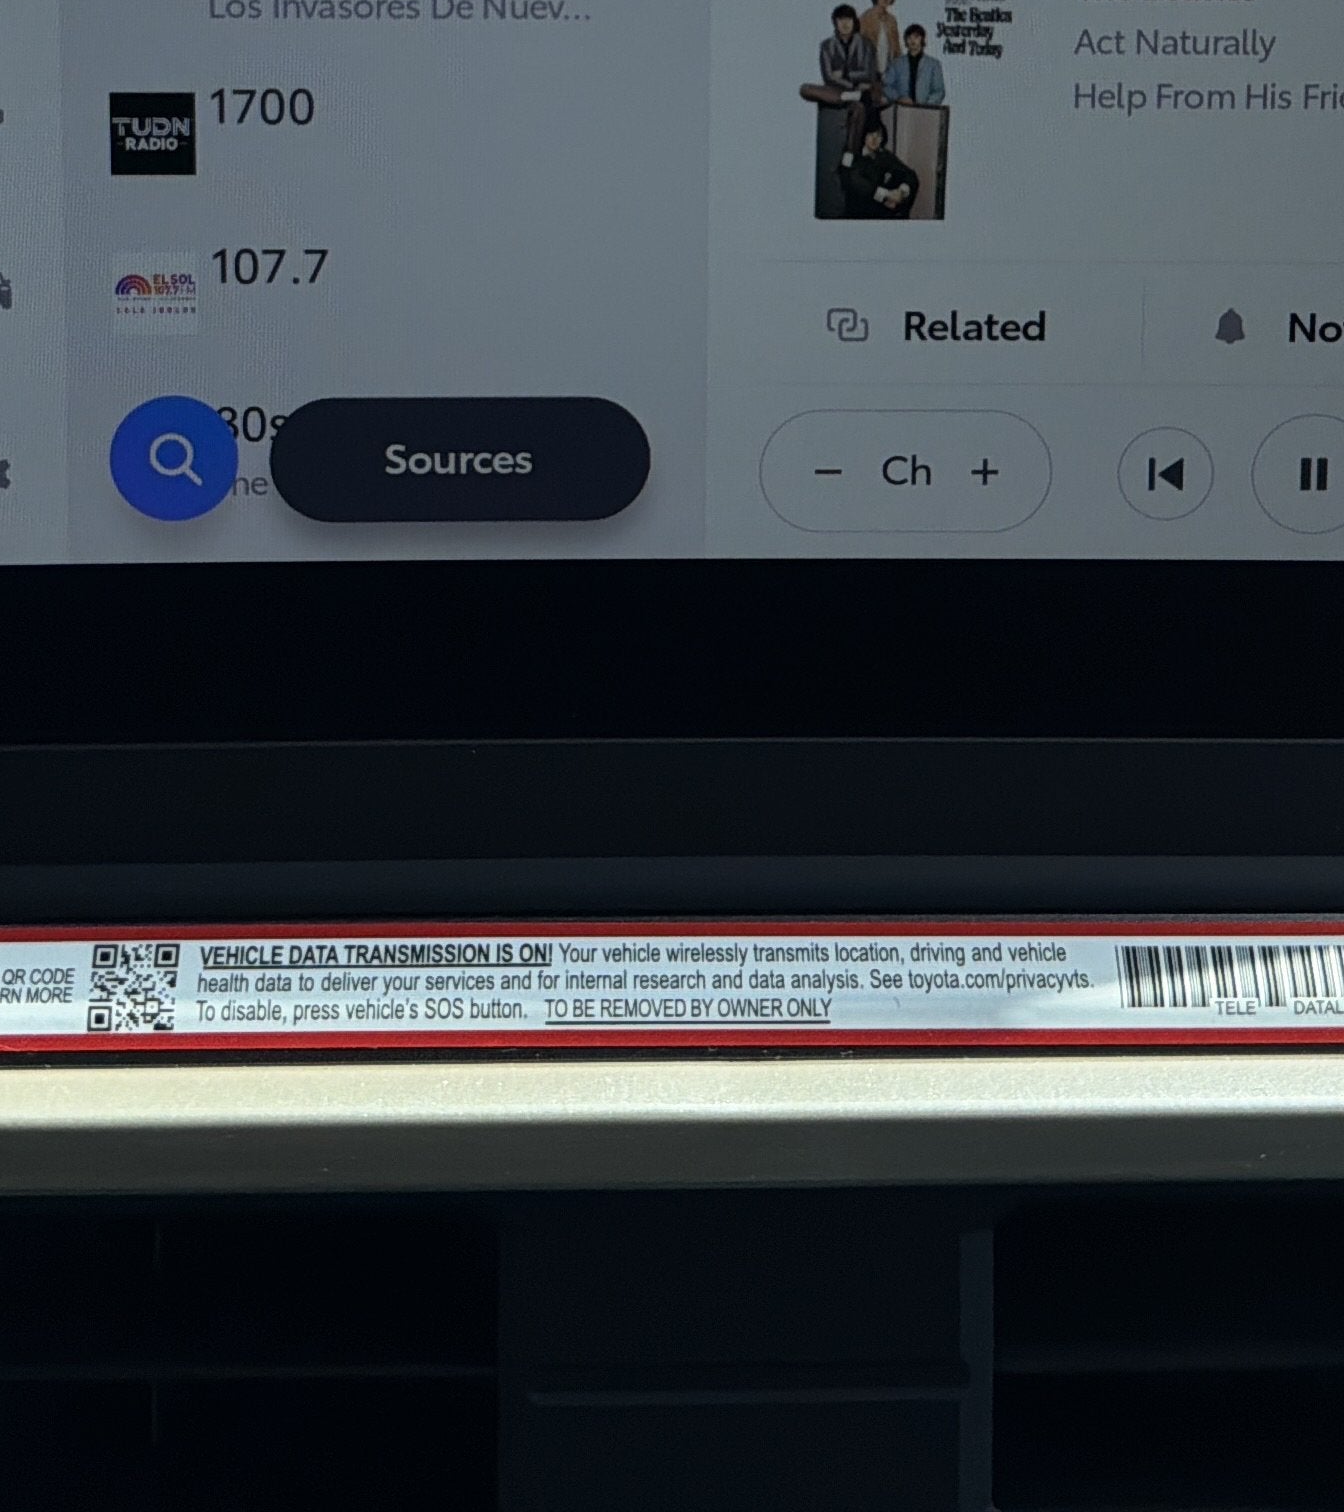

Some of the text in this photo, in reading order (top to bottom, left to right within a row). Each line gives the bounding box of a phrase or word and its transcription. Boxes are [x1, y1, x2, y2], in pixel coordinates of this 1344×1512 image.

[1073, 28, 1277, 64] Act Naturally
[210, 88, 315, 126] 1700
[1074, 81, 1147, 117] Help
[1156, 83, 1236, 110] From
[1245, 82, 1292, 110] His
[112, 117, 190, 137] TUDN
[125, 137, 179, 151] RADIO
[170, 273, 196, 285] SOL
[212, 248, 329, 285] 107.7
[904, 310, 1046, 342] Related
[385, 444, 533, 475] Sources
[882, 454, 932, 486] Ch
[200, 942, 1067, 968] VEHICLE DATA TRANSMISSION IS ON! Your vehicle wirelessly transmits location, driving and vehicle
[28, 967, 76, 986] CODE
[197, 968, 1095, 998] health data to deliver your services and for internal research and data analysis. See toyota.com/privacyvts.
[25, 985, 74, 1004] MORE
[1214, 1000, 1257, 1016] TELE
[195, 997, 831, 1027] To disable, press vehicle's SOS button. TO BE REMOVED BY OWNER ONLY
